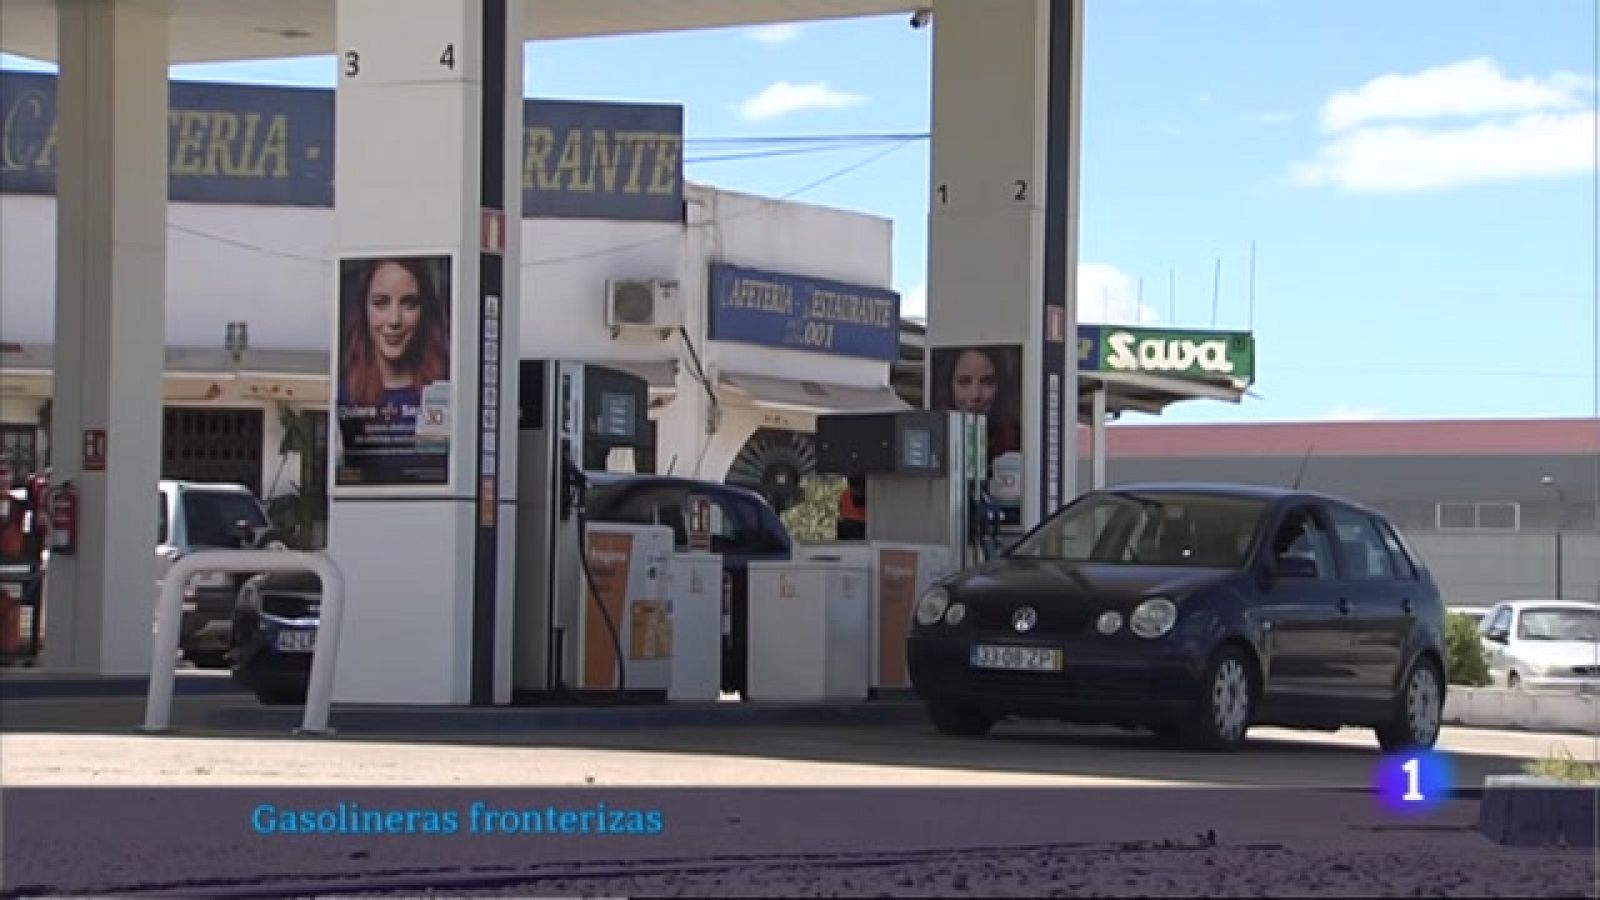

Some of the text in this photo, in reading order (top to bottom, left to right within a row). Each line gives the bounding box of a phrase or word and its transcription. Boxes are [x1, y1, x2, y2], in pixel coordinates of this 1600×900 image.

[345, 42, 455, 78] 3 4
[937, 179, 1027, 205] 1 2
